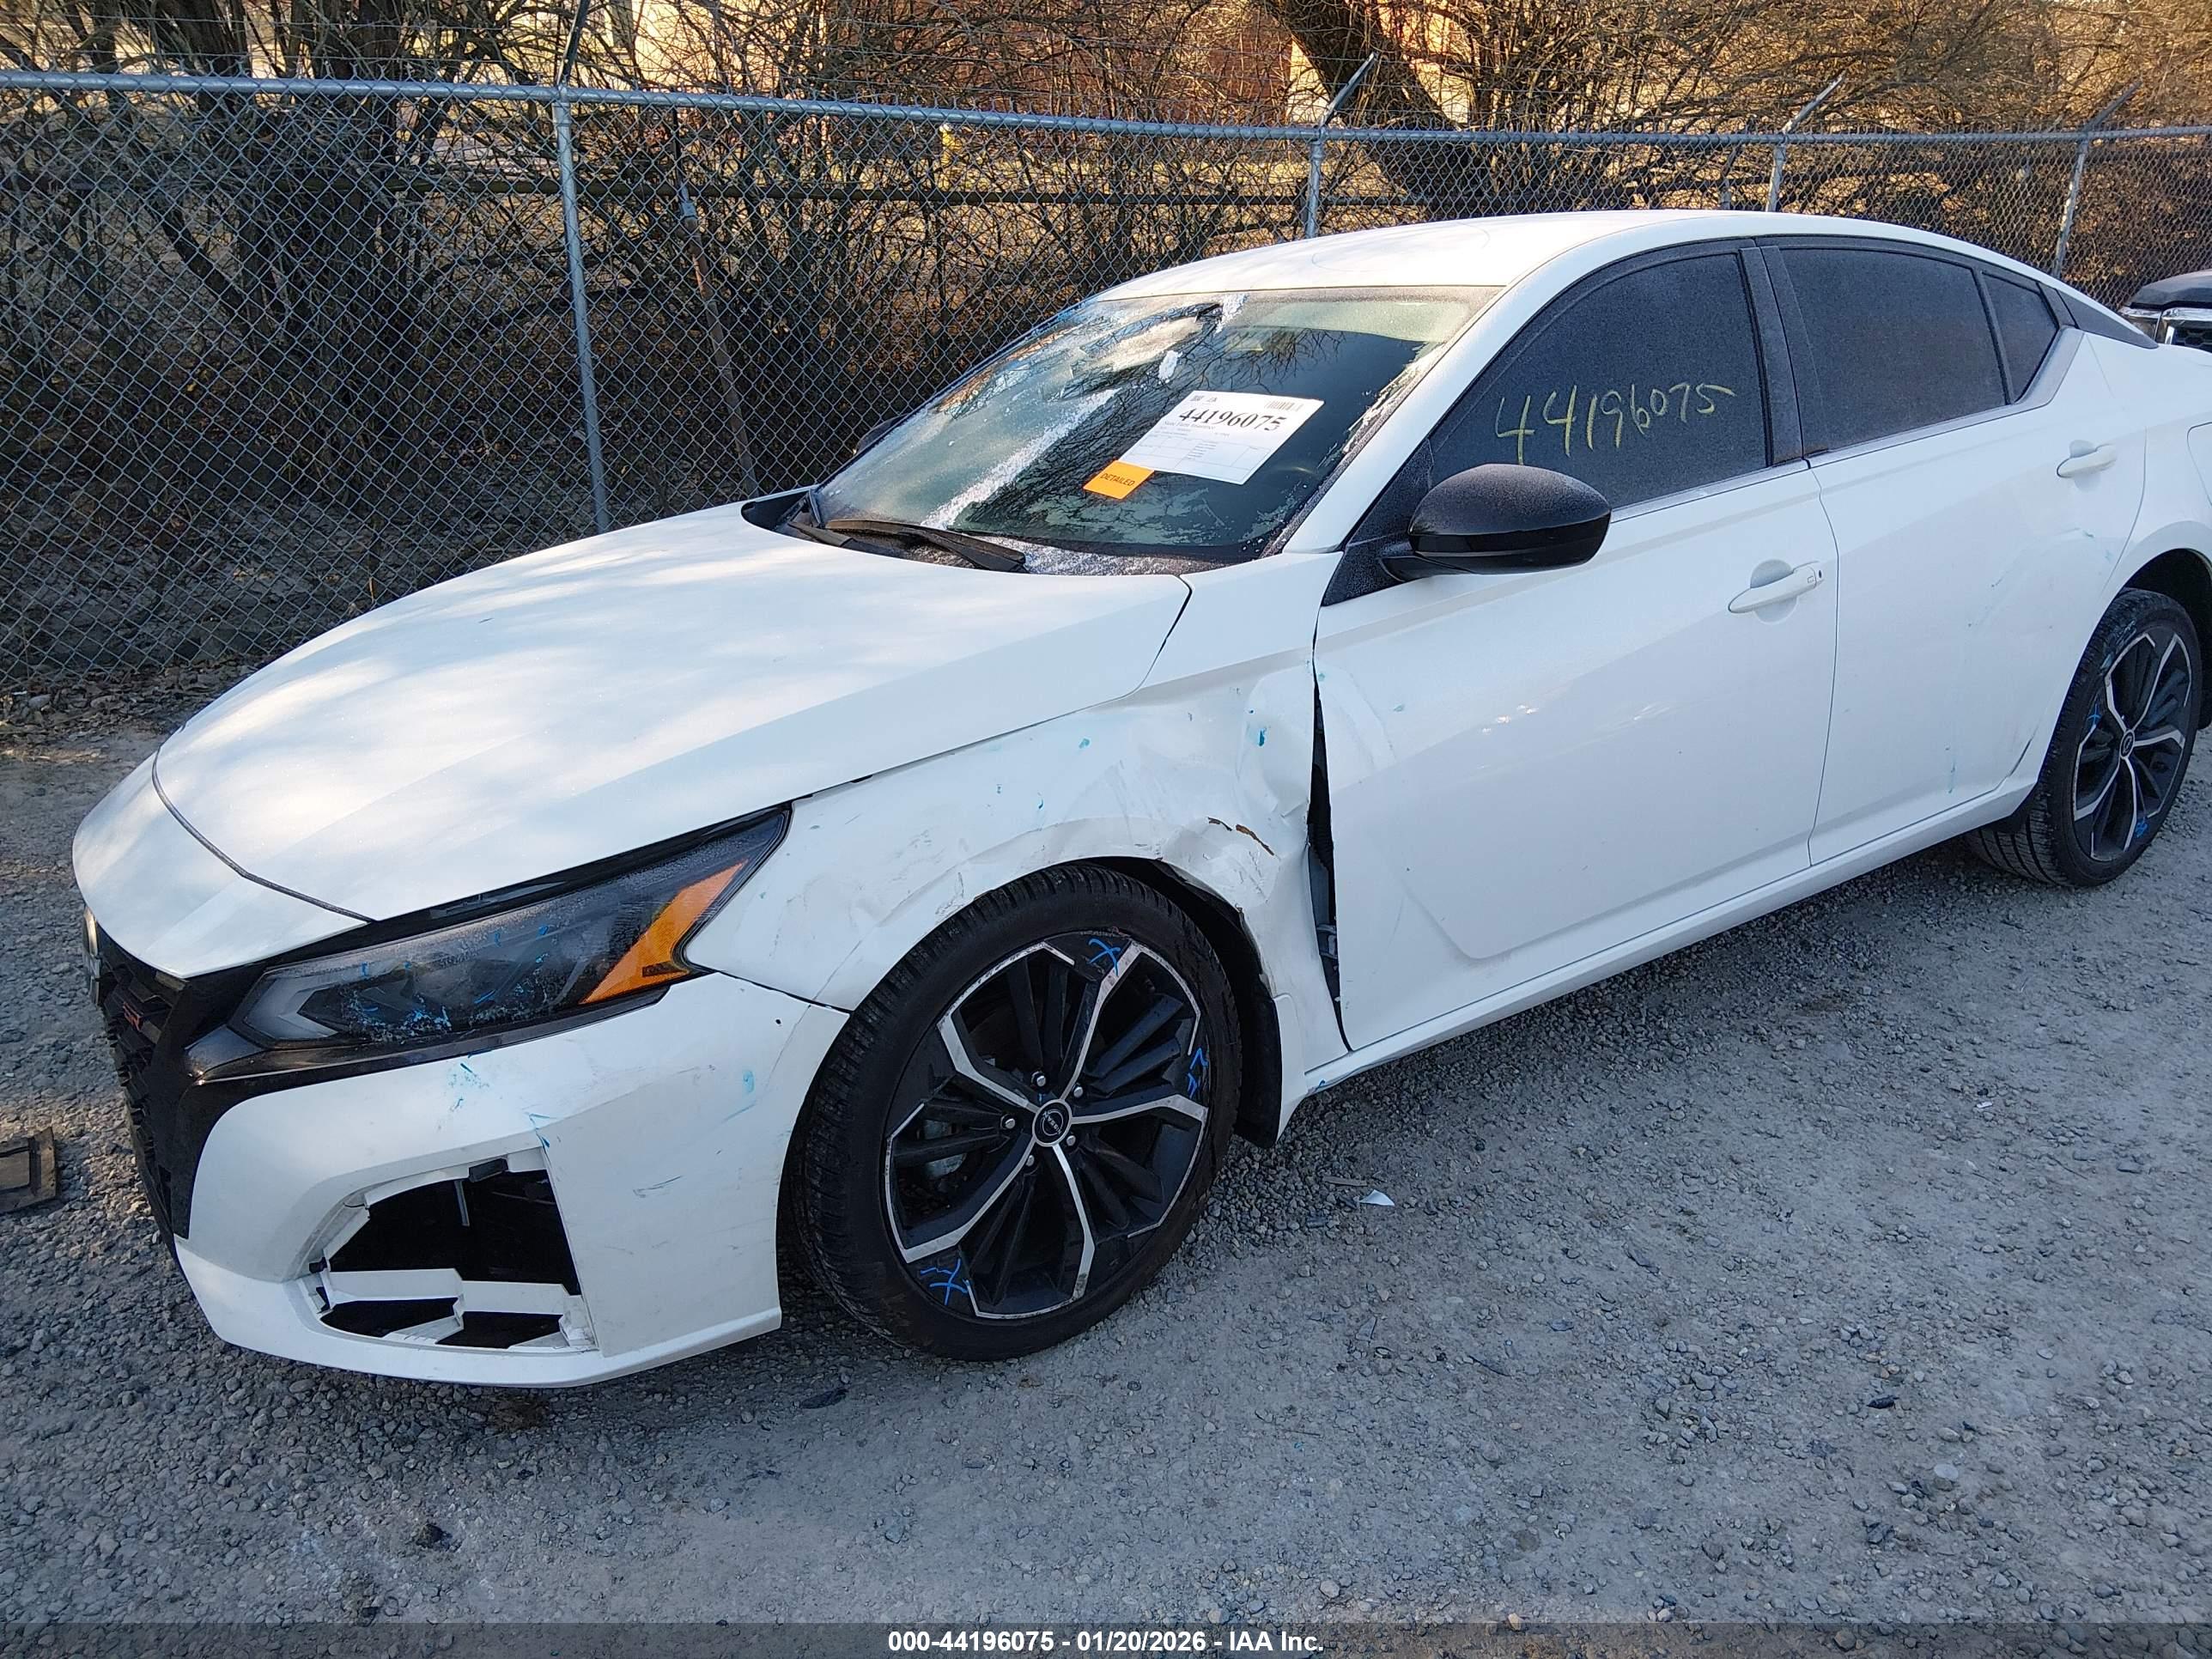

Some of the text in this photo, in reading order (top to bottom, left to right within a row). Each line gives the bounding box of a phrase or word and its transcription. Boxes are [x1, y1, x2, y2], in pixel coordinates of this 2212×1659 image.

[1179, 407, 1287, 431] 44196075
[1496, 384, 1735, 465] 44196075
[1100, 472, 1135, 486] DETAILED
